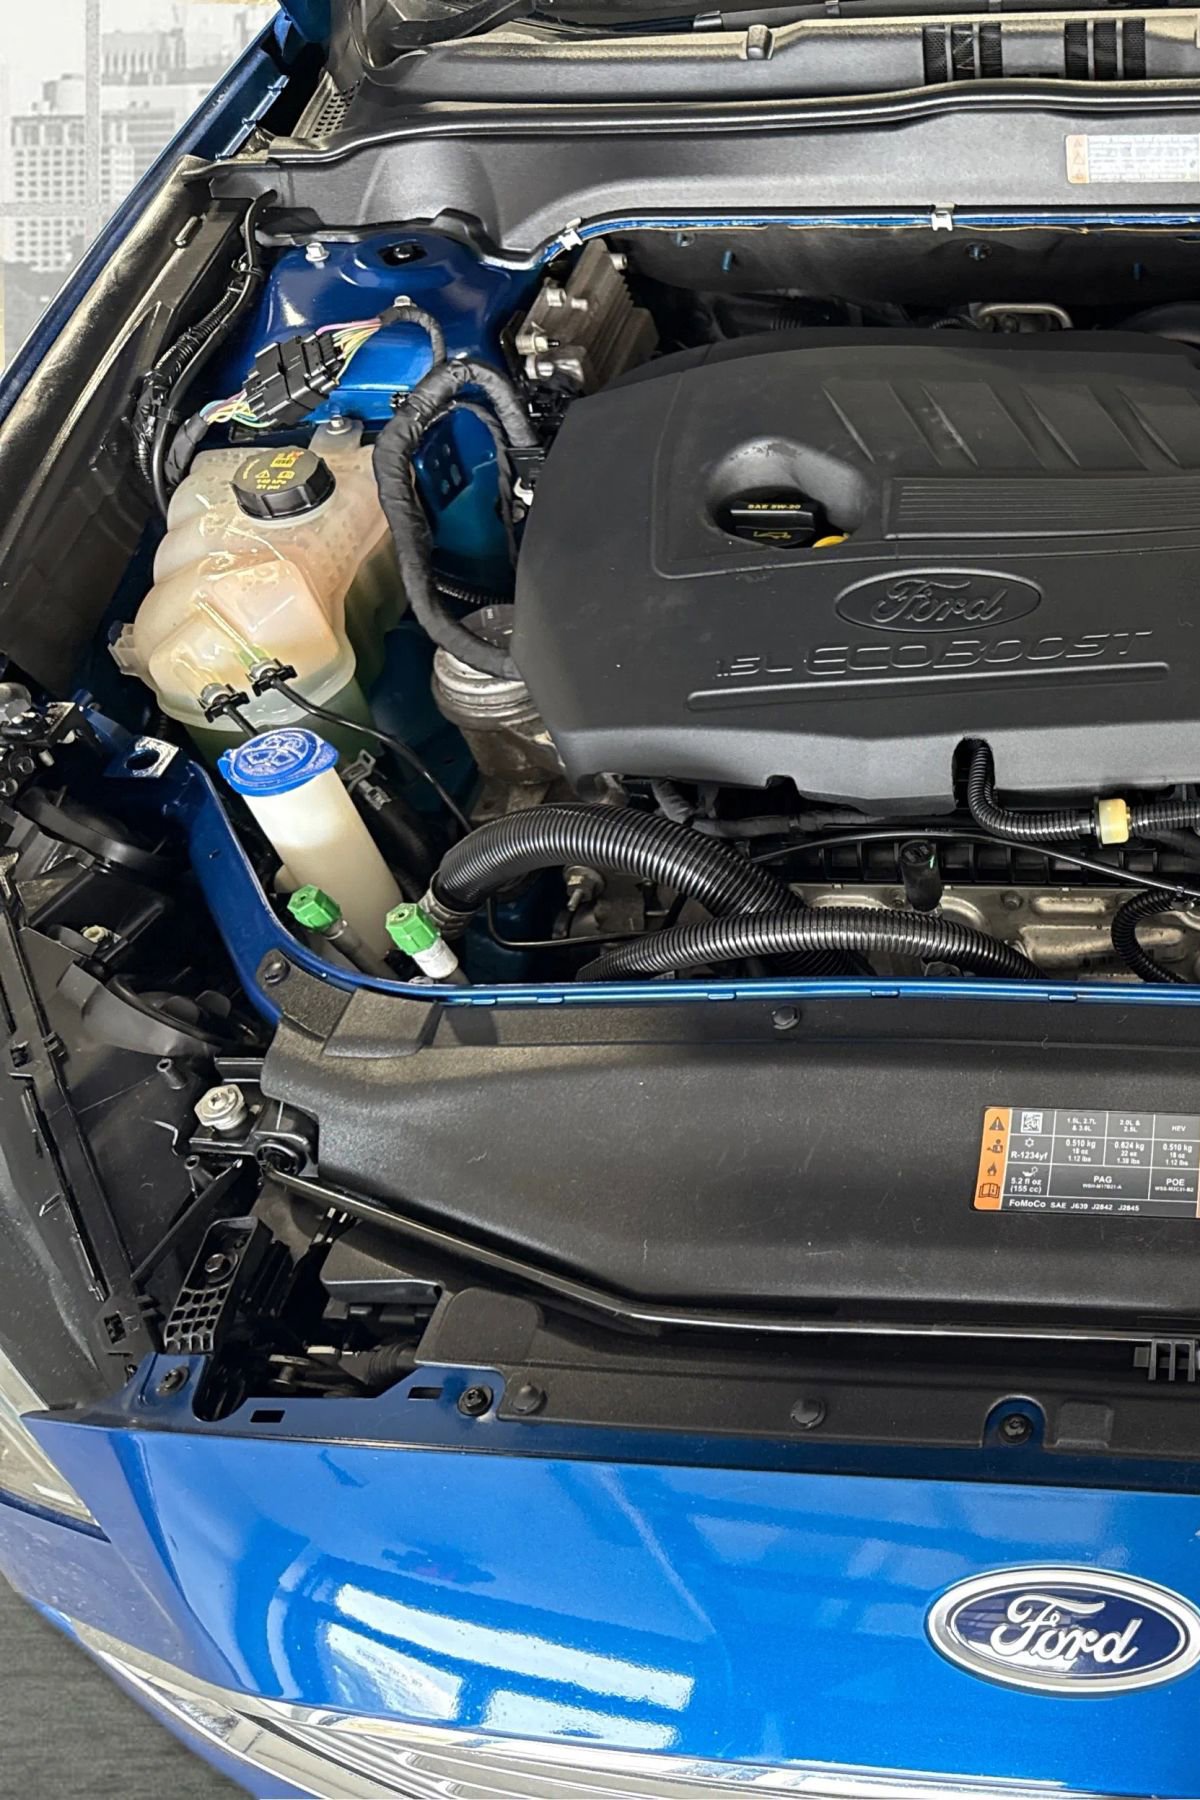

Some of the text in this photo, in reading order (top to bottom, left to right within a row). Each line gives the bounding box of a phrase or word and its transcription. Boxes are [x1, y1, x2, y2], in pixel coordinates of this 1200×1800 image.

[876, 579, 1003, 623] Ford
[805, 630, 1154, 677] ECOBOOST
[1066, 1139, 1096, 1149] 0.510 kg
[1136, 1142, 1144, 1151] kg
[1162, 1143, 1192, 1153] 0.510 kg
[1010, 1151, 1048, 1161] R-1234yf
[1094, 1176, 1112, 1184] PAG
[1166, 1178, 1185, 1186] POE
[1029, 1186, 1042, 1194] cc)
[1009, 1199, 1046, 1208] FoMoCo
[1118, 1204, 1140, 1212] J2845
[990, 1593, 1144, 1665] Ford
